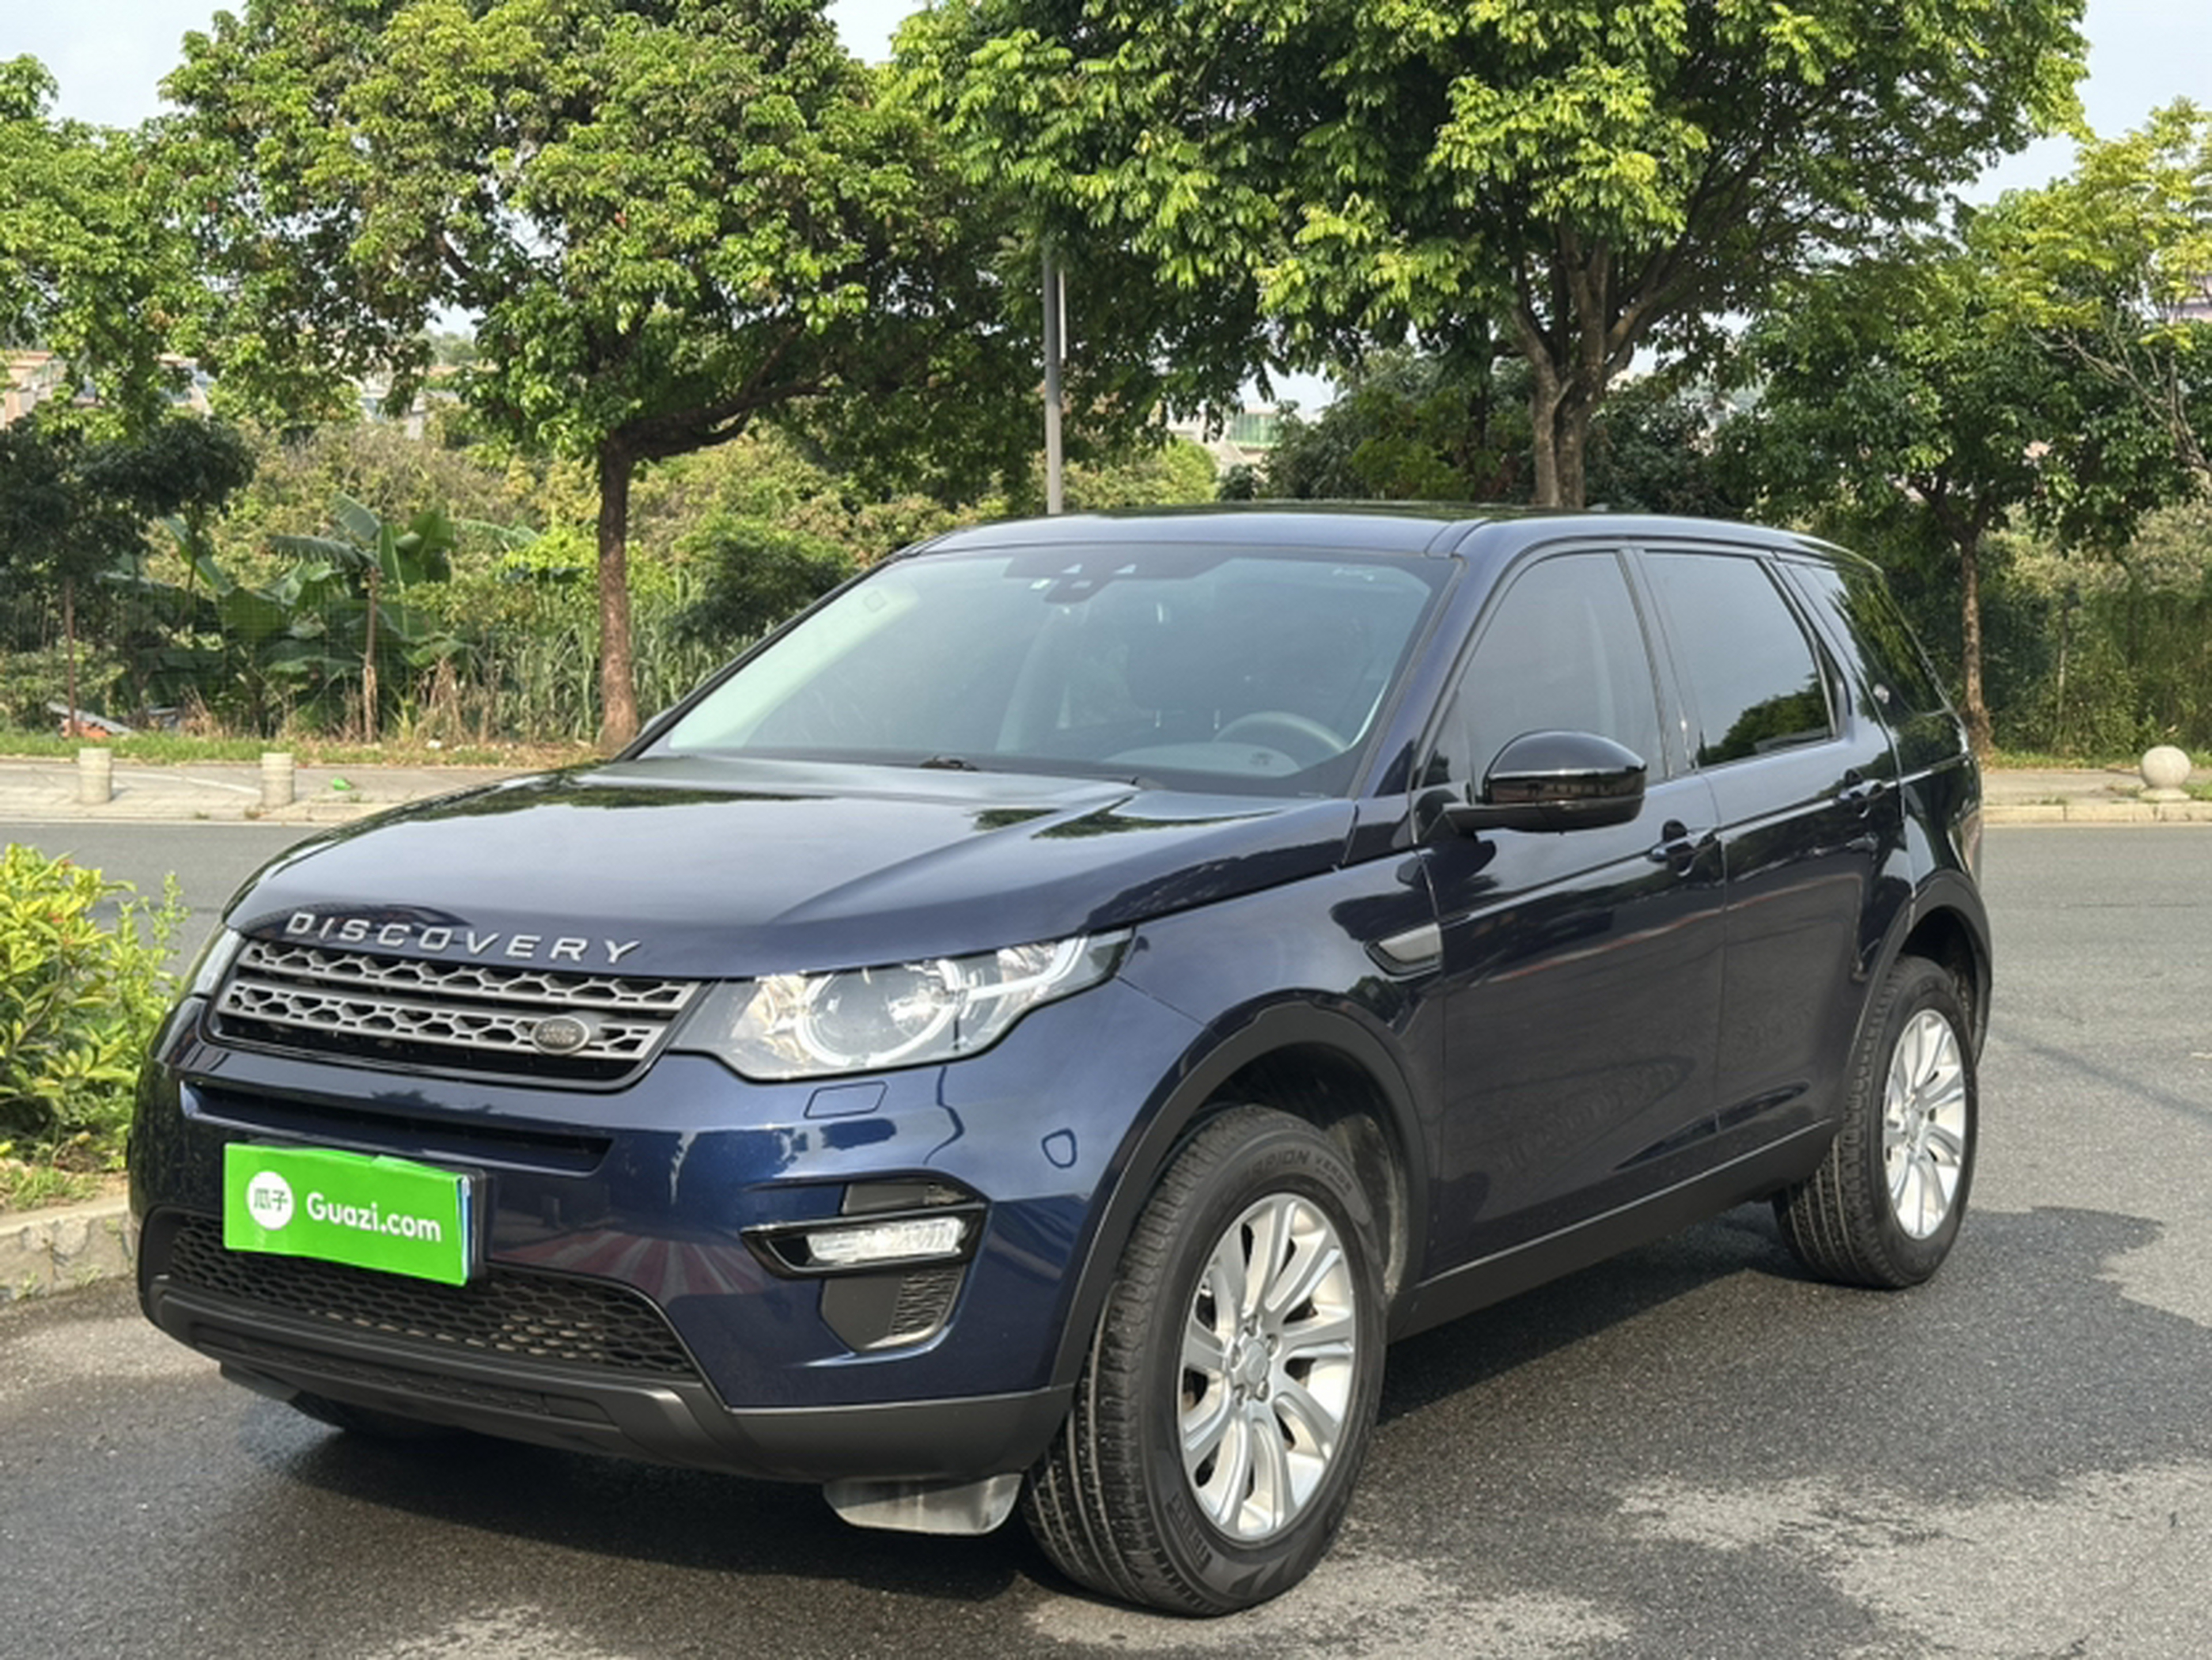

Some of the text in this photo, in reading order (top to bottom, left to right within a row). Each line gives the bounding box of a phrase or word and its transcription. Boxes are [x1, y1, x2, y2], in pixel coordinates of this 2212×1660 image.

[285, 912, 641, 964] DISCOVERY
[254, 1188, 288, 1211] 瓜子
[306, 1191, 441, 1242] Guazi.com
